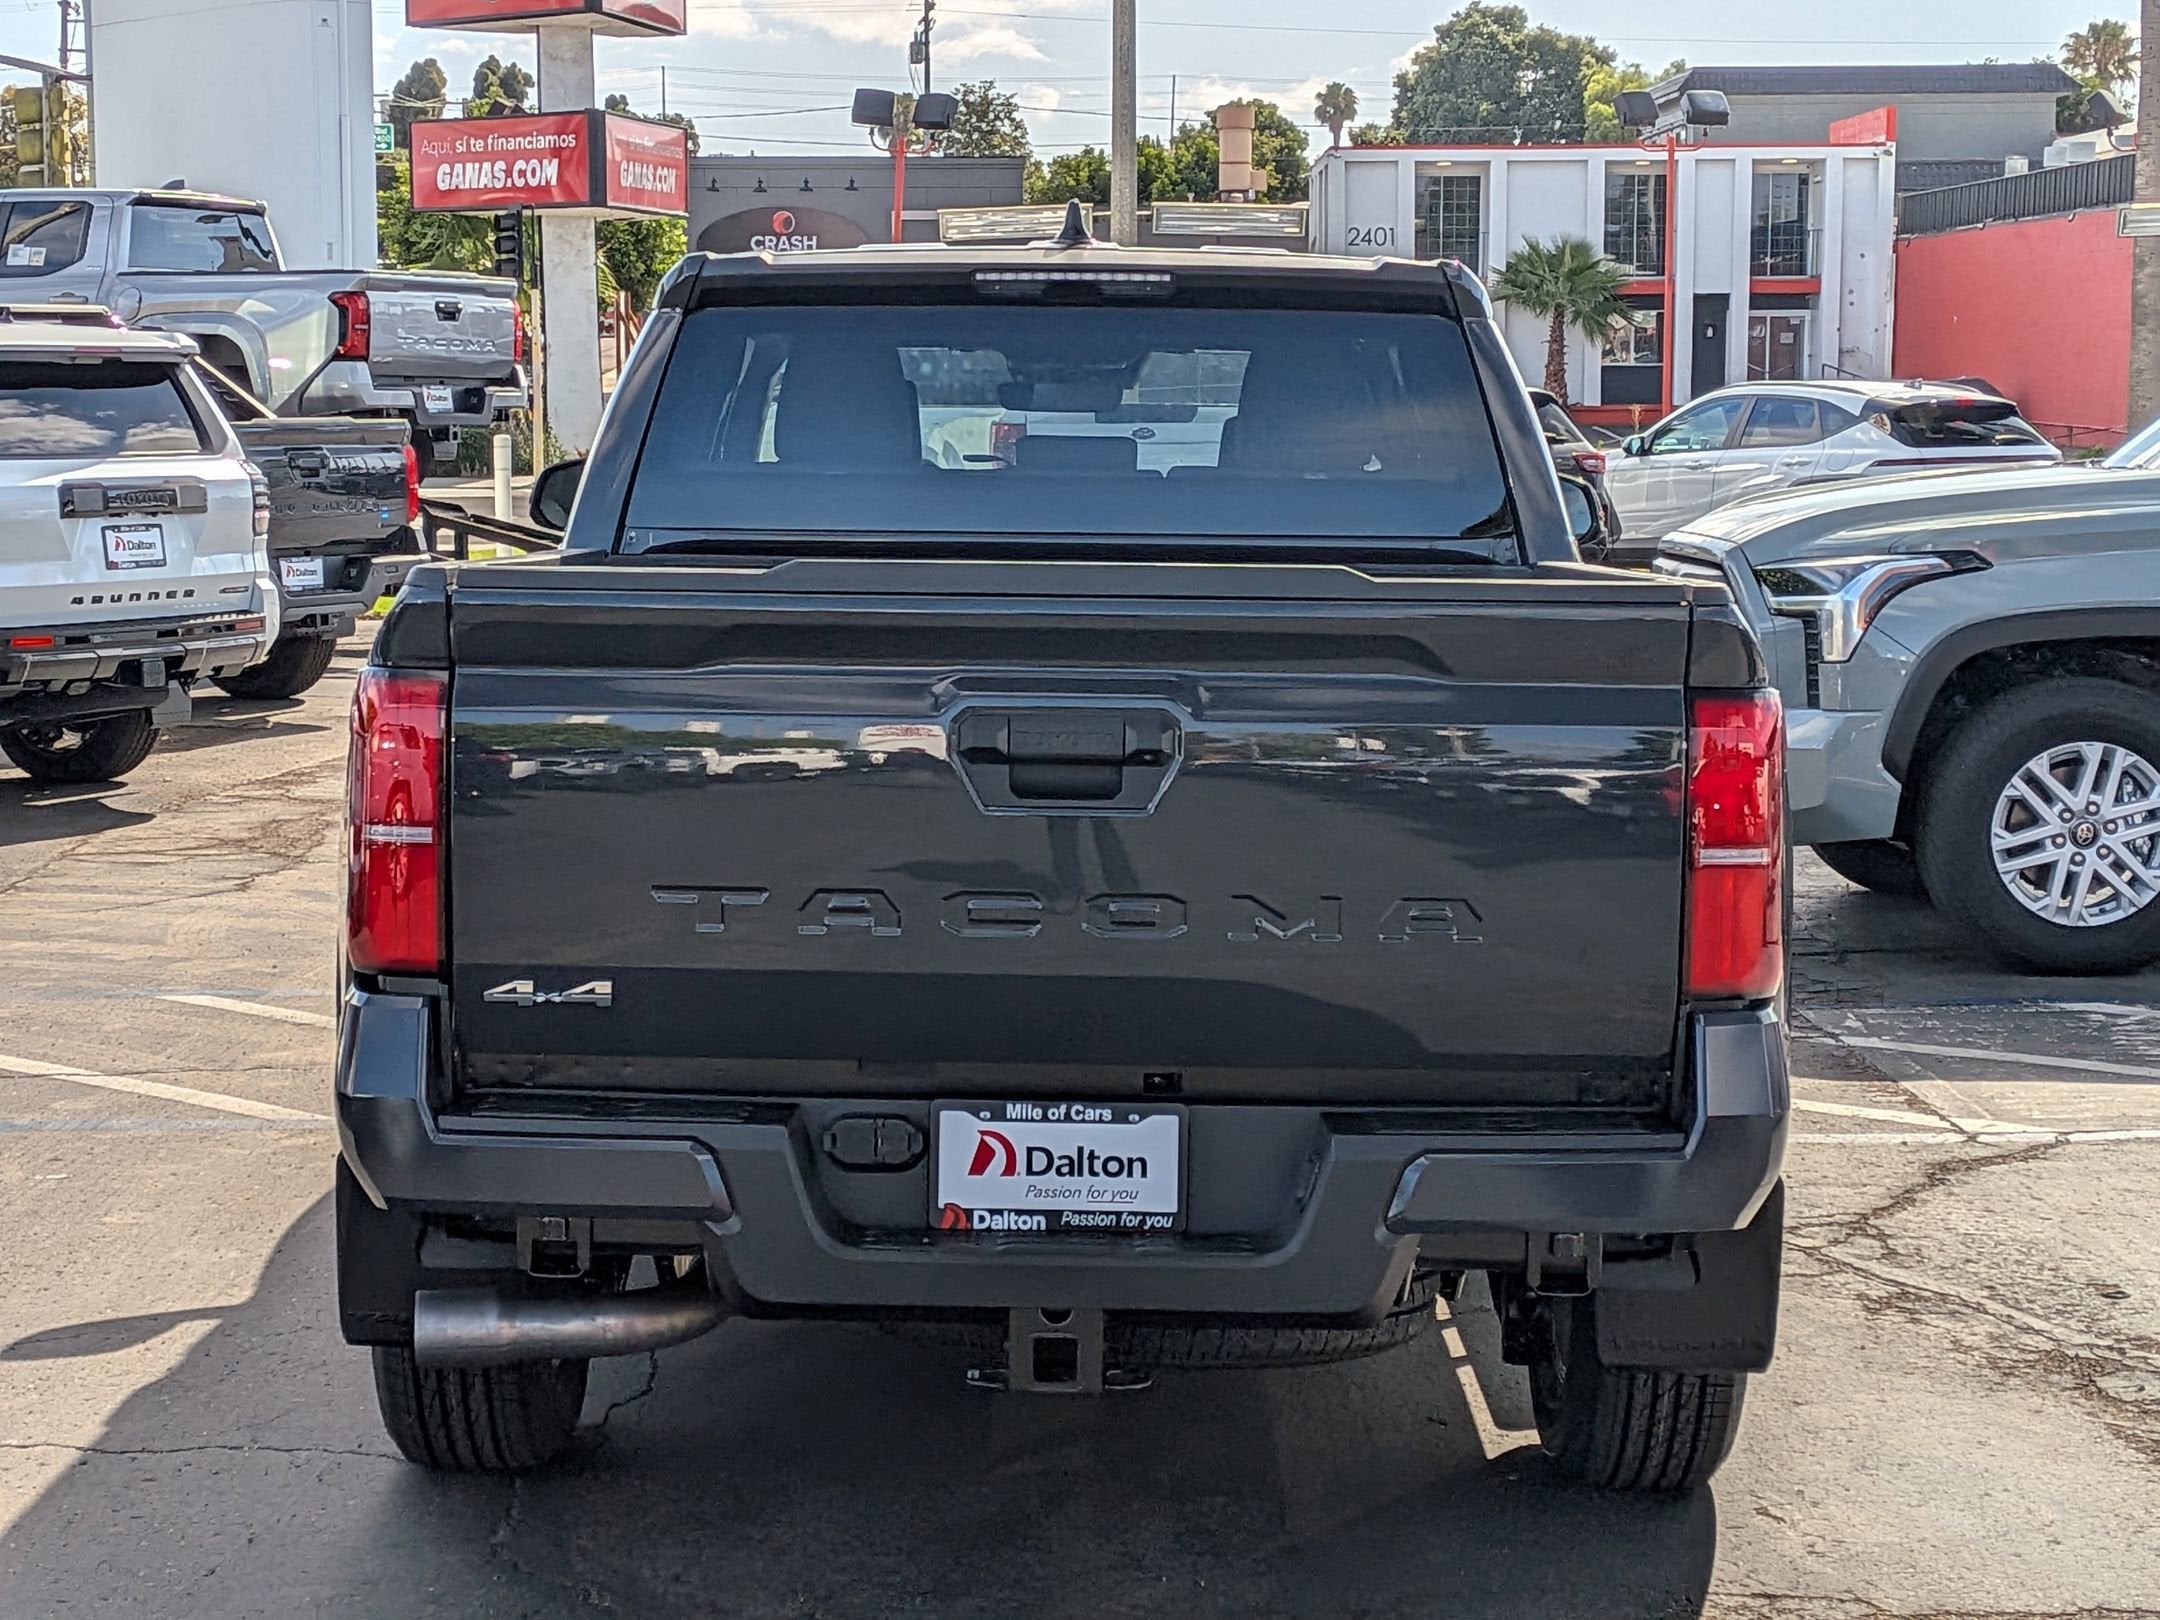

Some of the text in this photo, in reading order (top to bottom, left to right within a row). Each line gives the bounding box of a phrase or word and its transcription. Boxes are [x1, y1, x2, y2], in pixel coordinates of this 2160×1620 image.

[470, 136, 484, 152] te
[487, 131, 576, 151] financiamos
[436, 158, 560, 191] GANAS.COM
[620, 159, 677, 194] GANAS.COM
[750, 235, 818, 251] CRASH
[1348, 227, 1394, 246] 2401
[397, 336, 496, 352] TACOMA
[127, 539, 156, 551] Dalton
[70, 588, 196, 605] 4RUNNER
[650, 884, 1483, 944] TACOMA
[483, 980, 612, 1006] 4x4
[1006, 1103, 1112, 1121] Mile of Cars
[1025, 1146, 1148, 1178] Dalton
[1025, 1184, 1139, 1202] Passion for you
[973, 1210, 1047, 1230] Dalton
[1061, 1211, 1174, 1229] Passion for you
